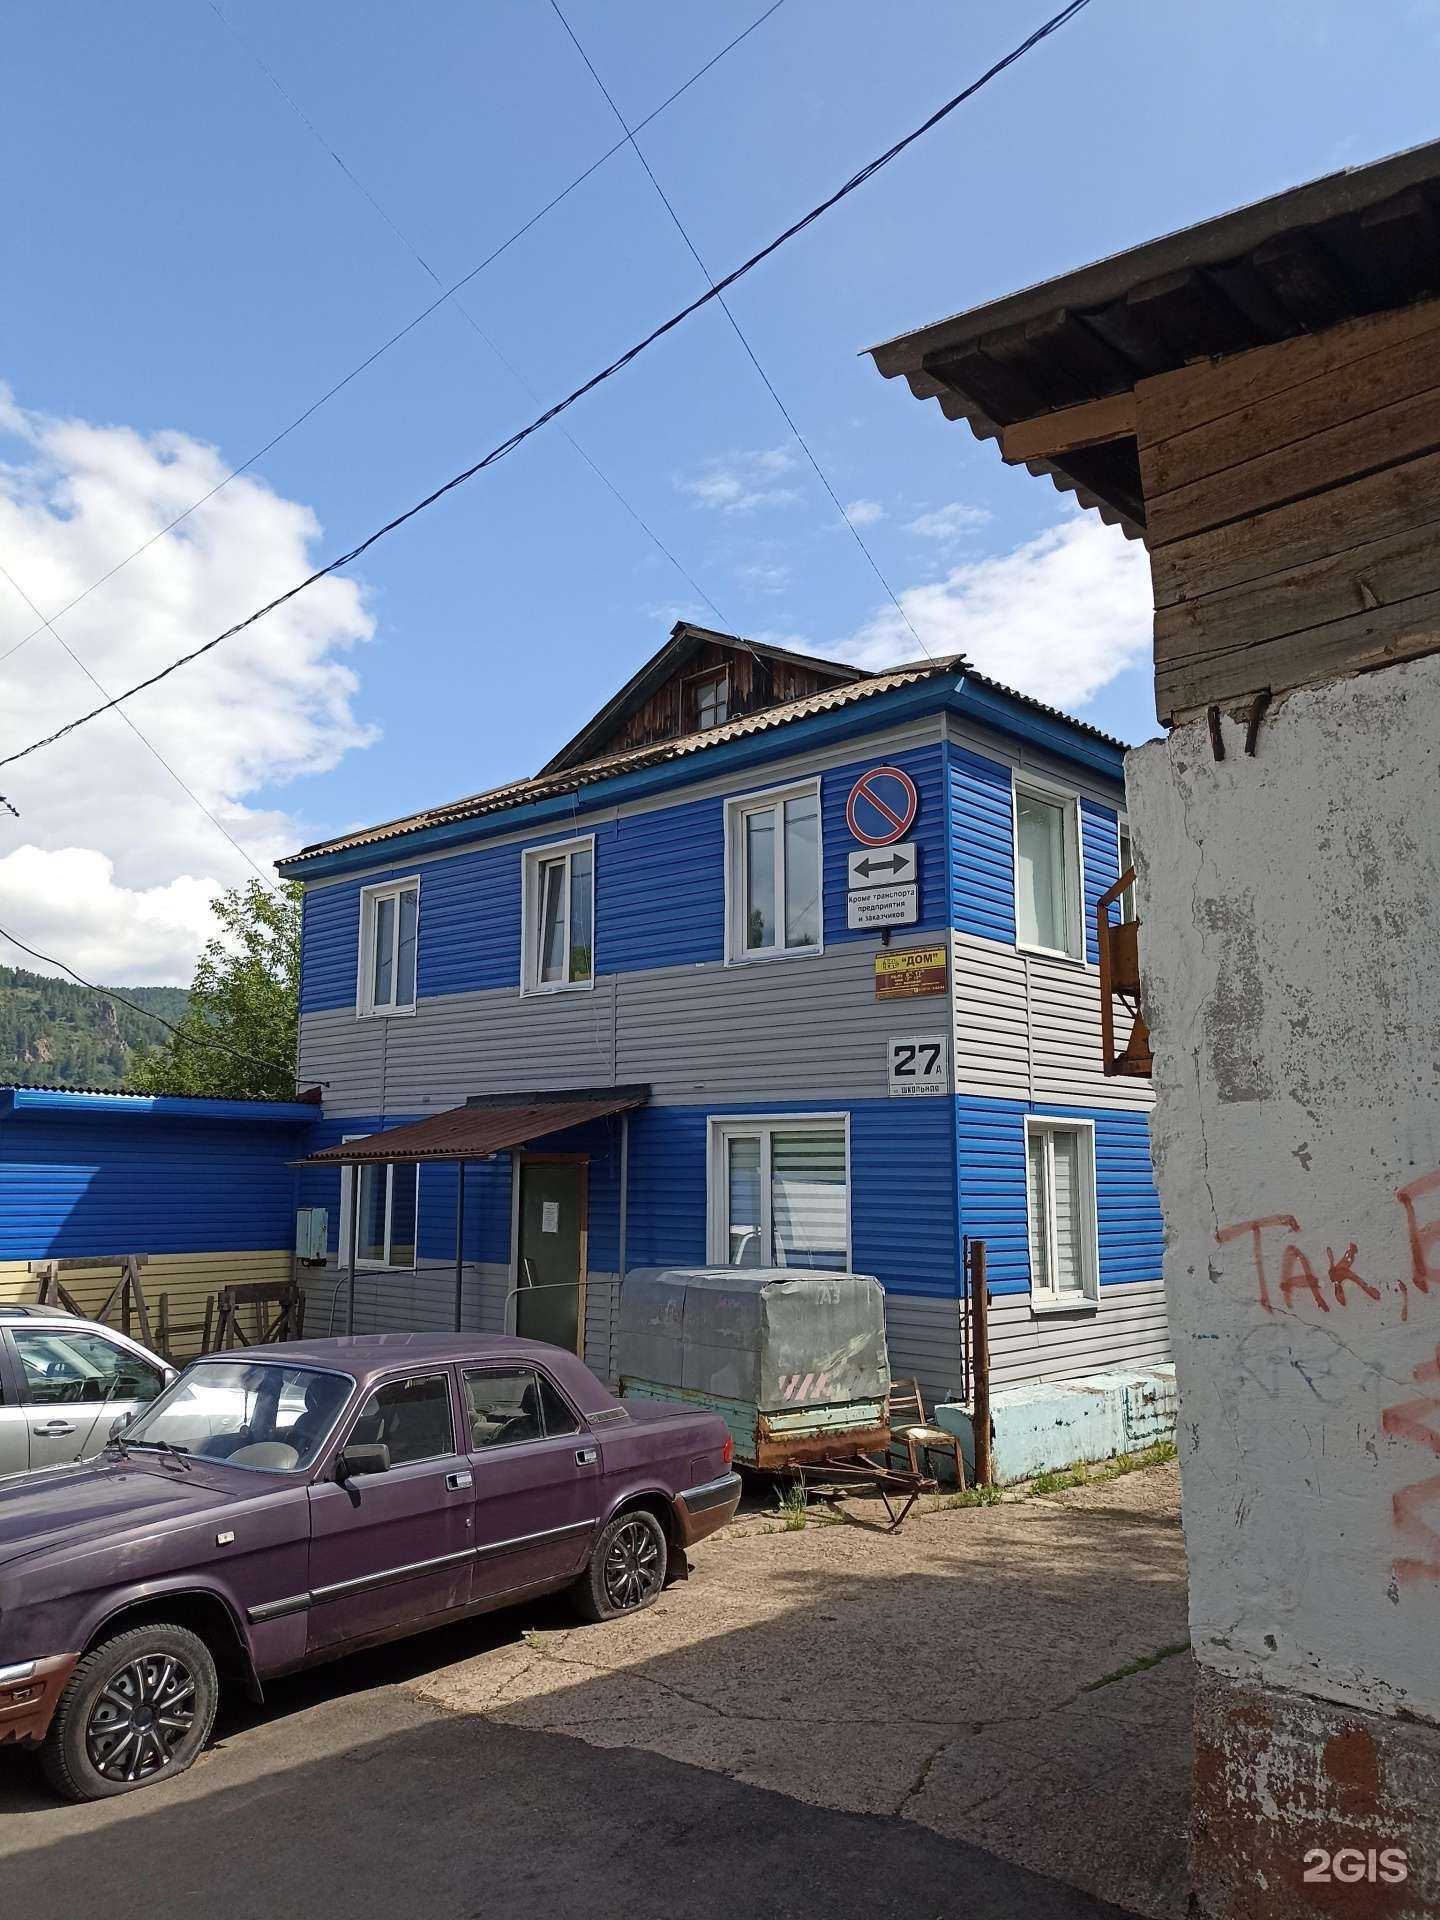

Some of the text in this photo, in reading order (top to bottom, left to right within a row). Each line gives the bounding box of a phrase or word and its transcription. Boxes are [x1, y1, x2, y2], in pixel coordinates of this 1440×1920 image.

[849, 889, 915, 904] Кроме транспорта
[858, 901, 905, 912] предприятия
[865, 911, 904, 922] заказчиков
